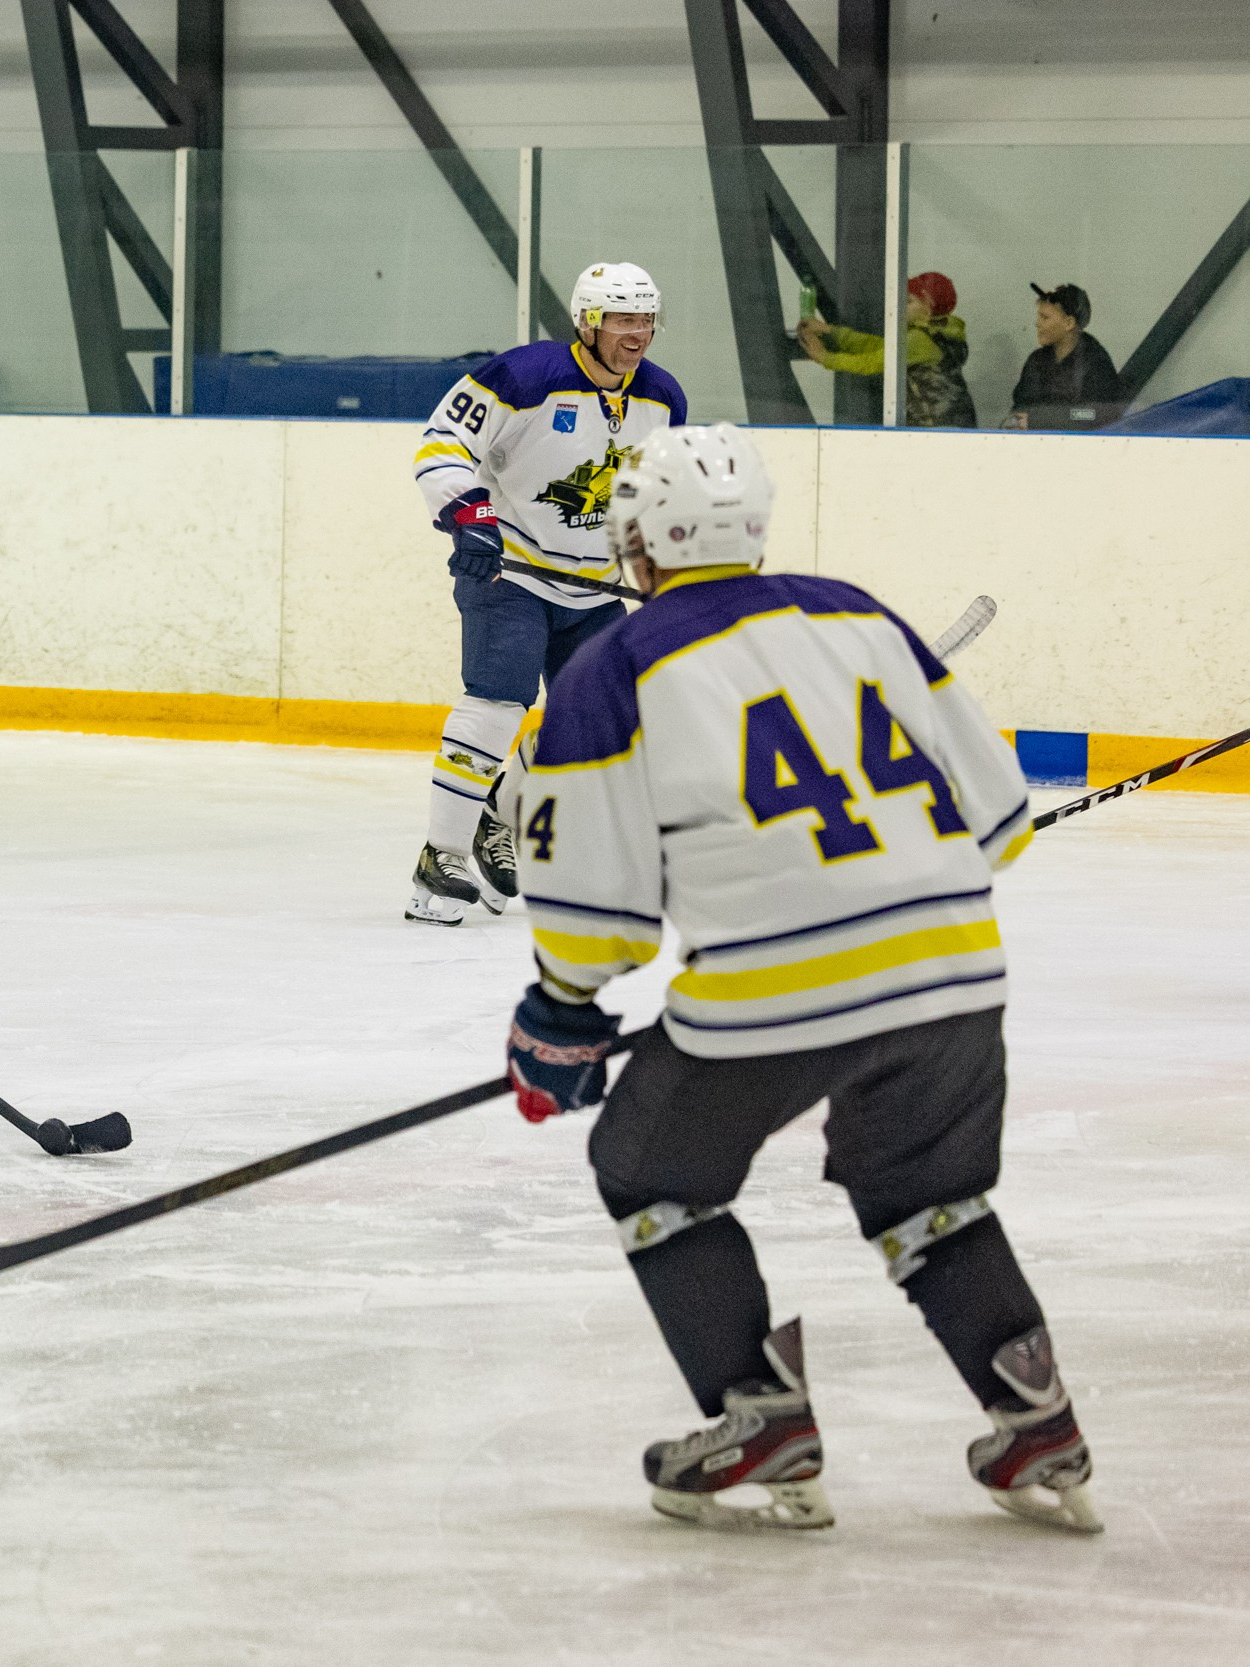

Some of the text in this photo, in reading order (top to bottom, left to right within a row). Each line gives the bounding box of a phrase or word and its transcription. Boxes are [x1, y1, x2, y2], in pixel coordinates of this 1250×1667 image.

[446, 392, 487, 435] 99
[739, 675, 972, 866] 44
[1055, 772, 1151, 824] CCM
[515, 793, 557, 863] 4
